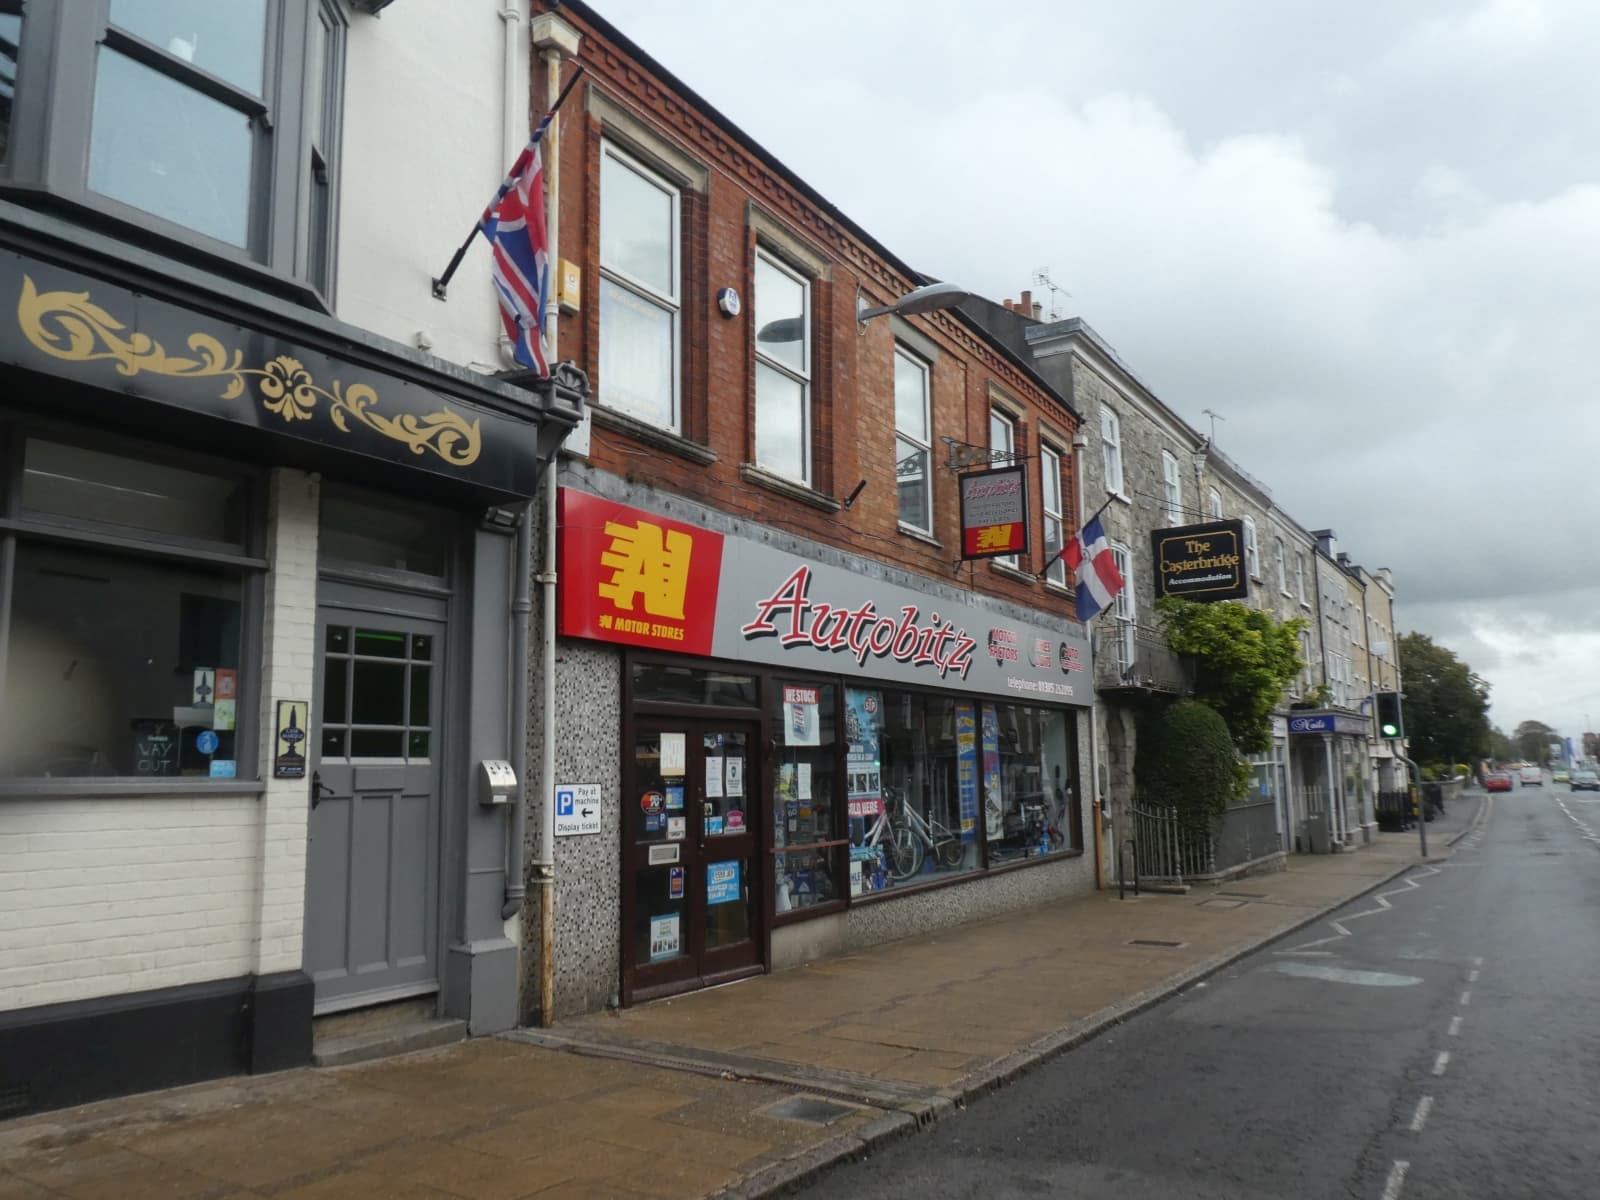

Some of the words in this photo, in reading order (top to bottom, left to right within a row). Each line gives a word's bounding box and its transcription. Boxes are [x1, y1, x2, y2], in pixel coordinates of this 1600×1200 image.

[1185, 540, 1211, 555] The
[1161, 554, 1240, 575] Casterbridge
[615, 617, 650, 635] MOTOR
[651, 623, 684, 641] STORES
[741, 564, 976, 679] Autobitz
[785, 688, 796, 703] WE
[796, 690, 816, 705] STOCK
[578, 787, 589, 796] Pay
[590, 786, 597, 795] at
[560, 793, 572, 815] P
[575, 797, 599, 805] machine
[861, 799, 878, 815] HERE
[557, 823, 580, 832] Display
[581, 822, 599, 830] ticket
